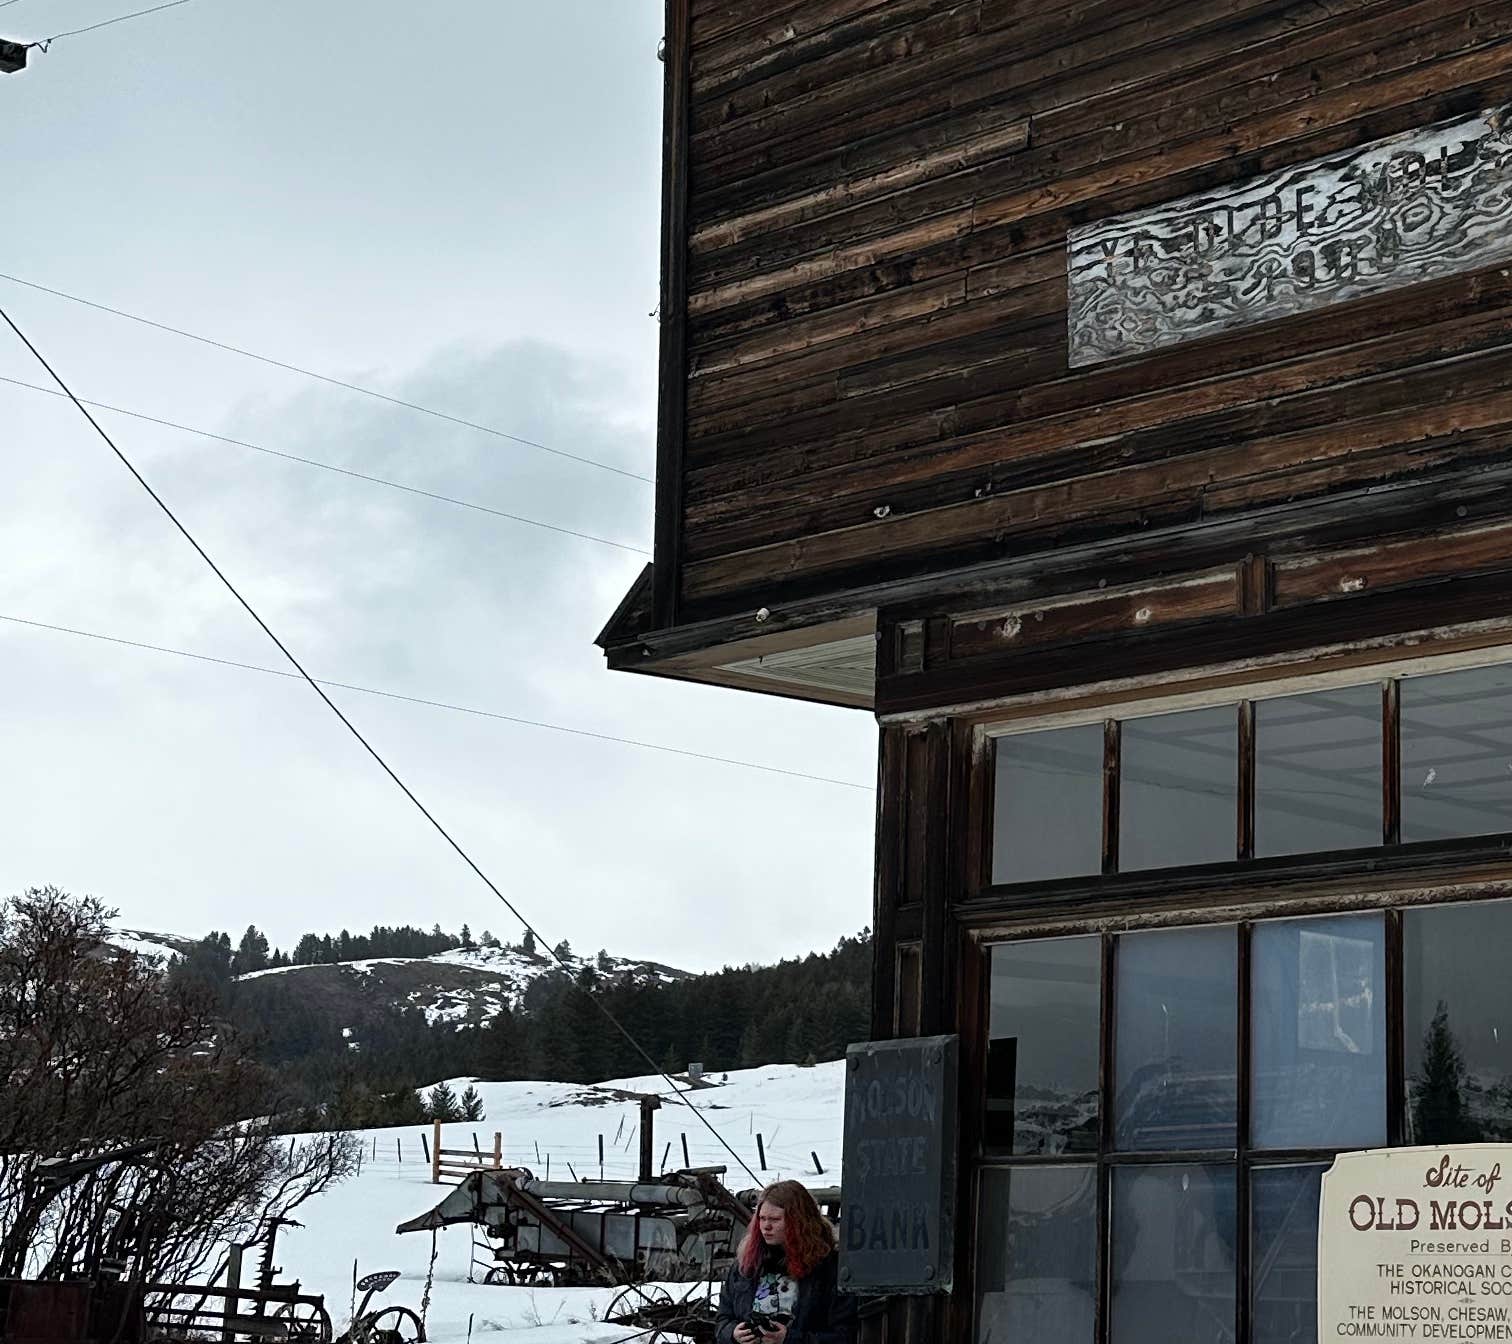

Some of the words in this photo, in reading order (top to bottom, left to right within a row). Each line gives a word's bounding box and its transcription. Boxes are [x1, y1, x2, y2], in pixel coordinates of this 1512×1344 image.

[856, 1137, 929, 1184] STATE
[1423, 1154, 1474, 1188] Site
[1471, 1162, 1501, 1194] of
[1348, 1194, 1421, 1231] OLD
[847, 1205, 930, 1251] BANK
[1410, 1239, 1490, 1254] Preserved
[1376, 1264, 1405, 1277] THE
[1411, 1264, 1496, 1278] OKANOGAN
[1390, 1280, 1477, 1295] HISTORICAL
[1348, 1305, 1376, 1319] THE
[1382, 1306, 1445, 1323] MOLSON,
[1448, 1307, 1511, 1324] CHESAW,
[1336, 1322, 1418, 1337] COMMUNITY
